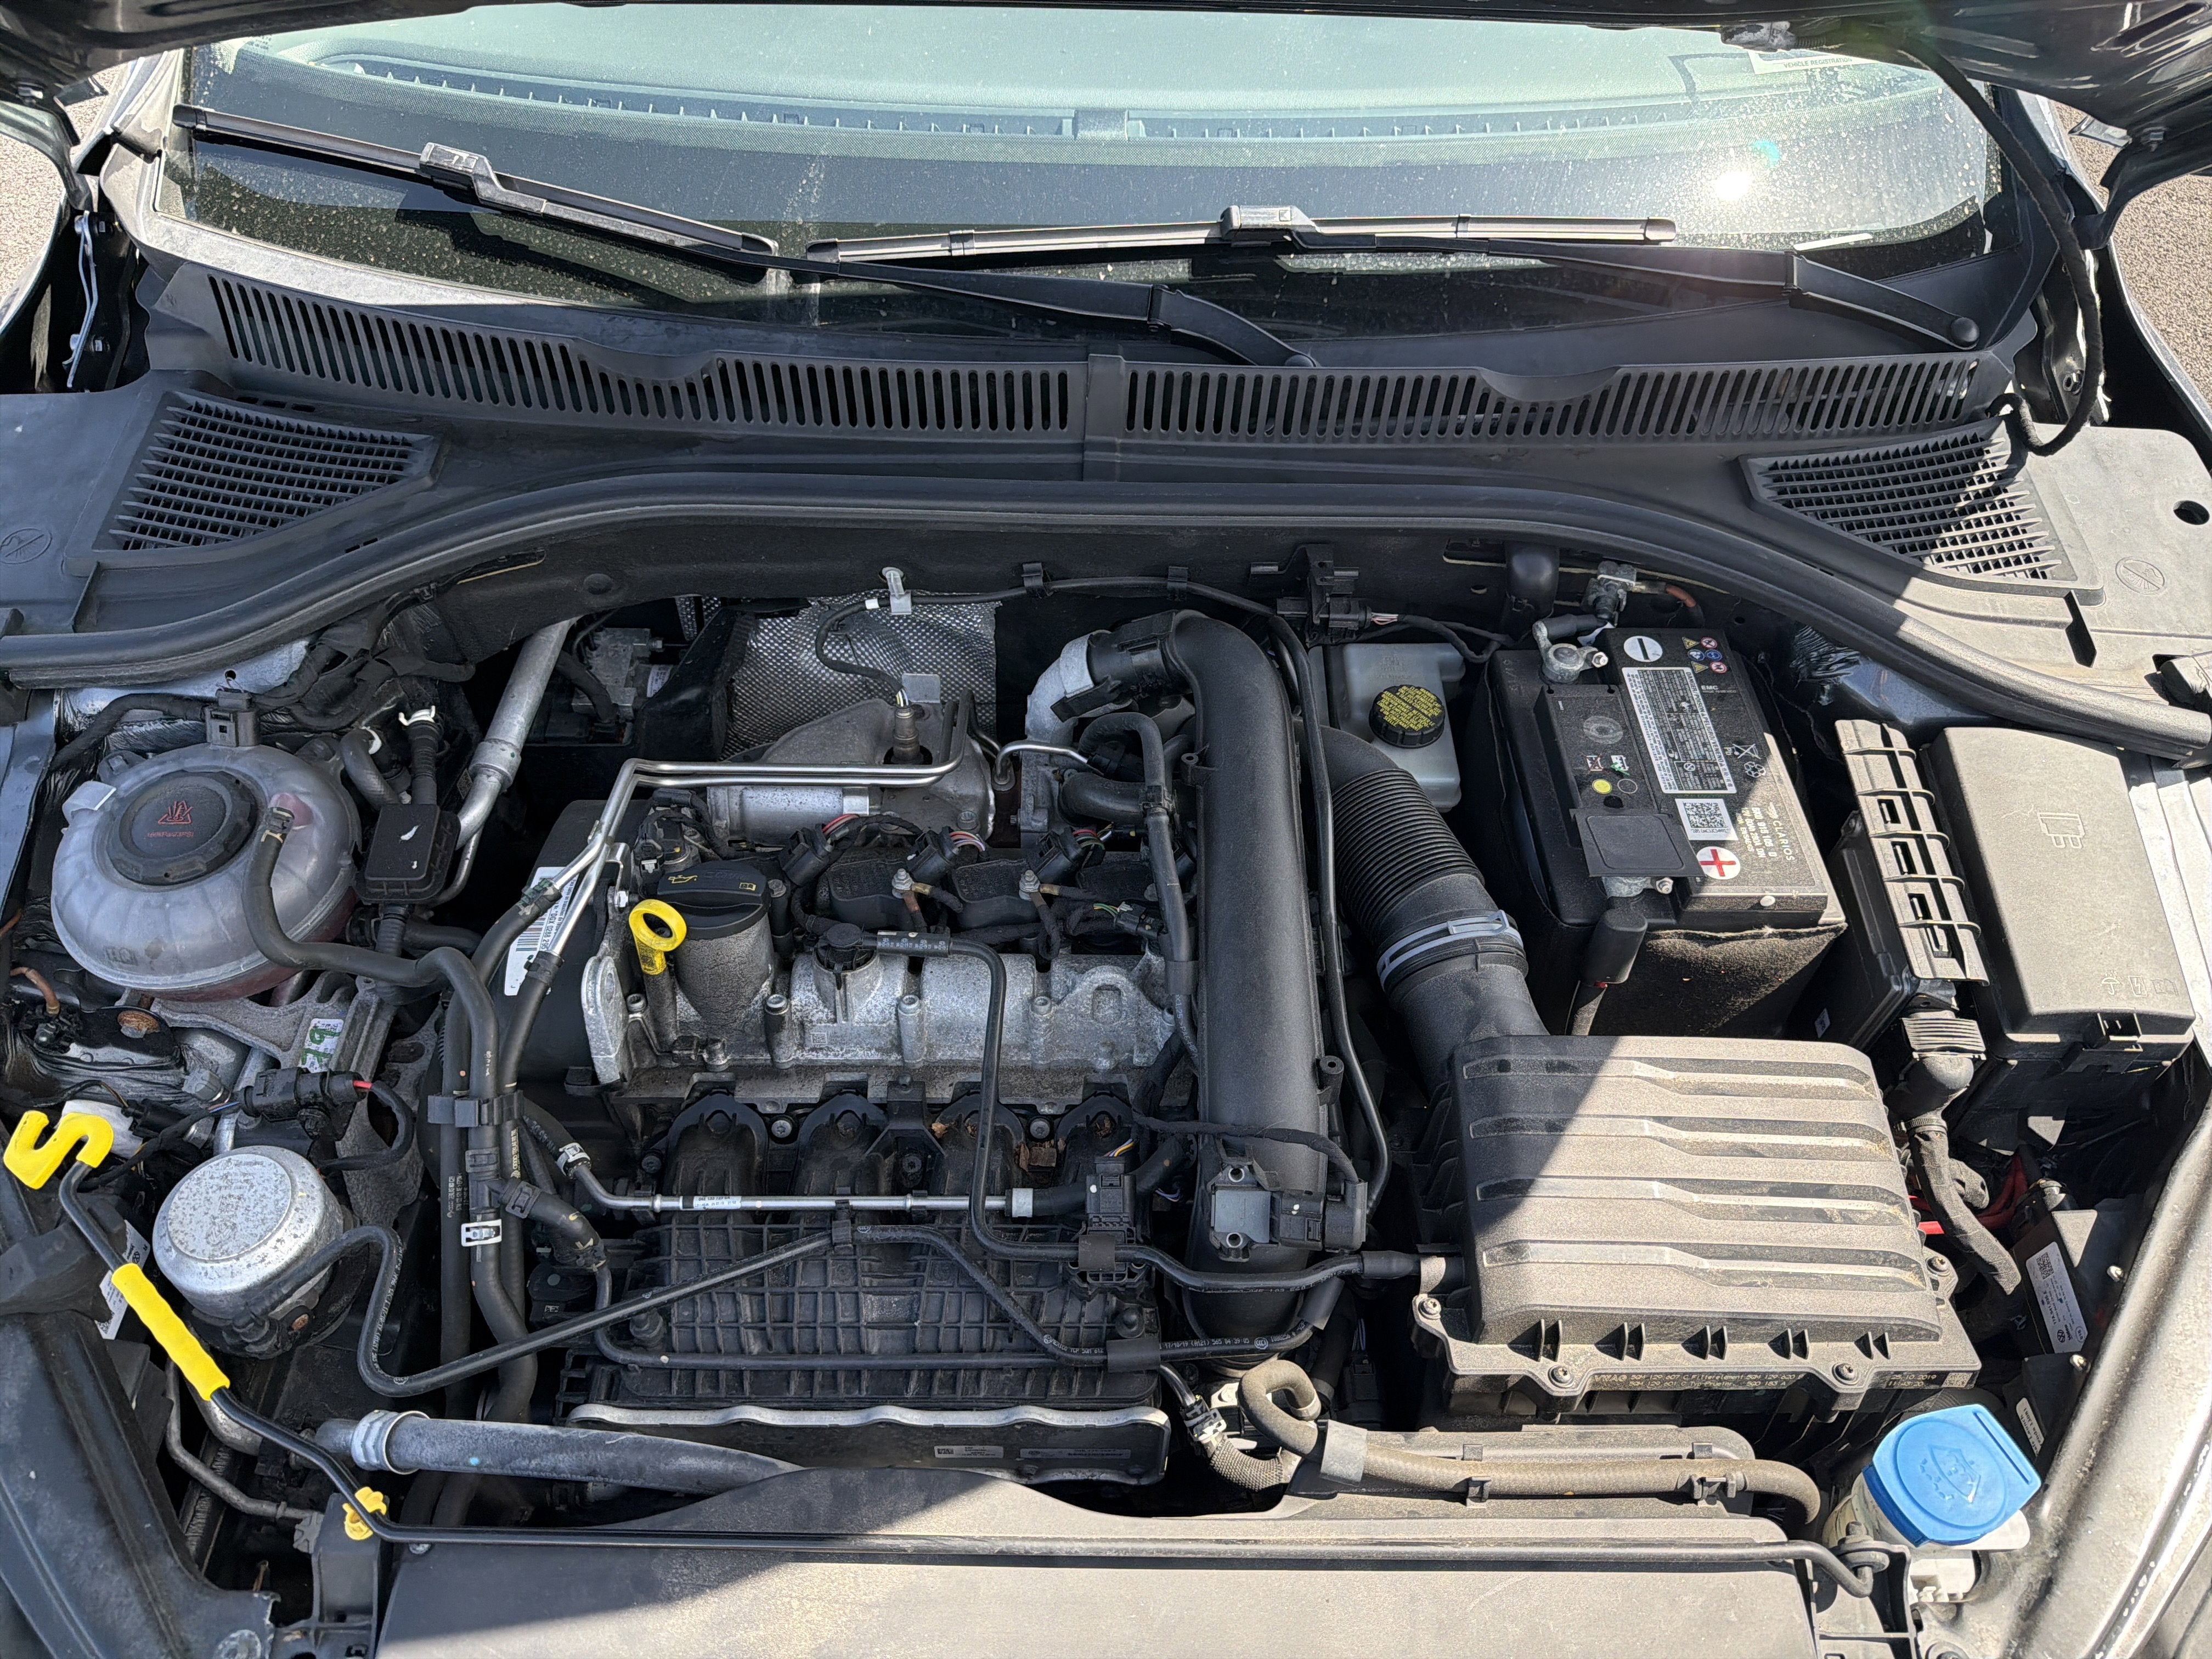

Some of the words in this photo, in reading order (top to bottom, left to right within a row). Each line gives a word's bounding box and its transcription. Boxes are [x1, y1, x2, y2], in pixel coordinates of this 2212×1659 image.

[1724, 747, 1733, 755] Pb
[1773, 820, 1795, 860] CLARIOS
[544, 926, 554, 938] 0288
[540, 939, 550, 950] 295
[1052, 1339, 1068, 1351] MEXICO
